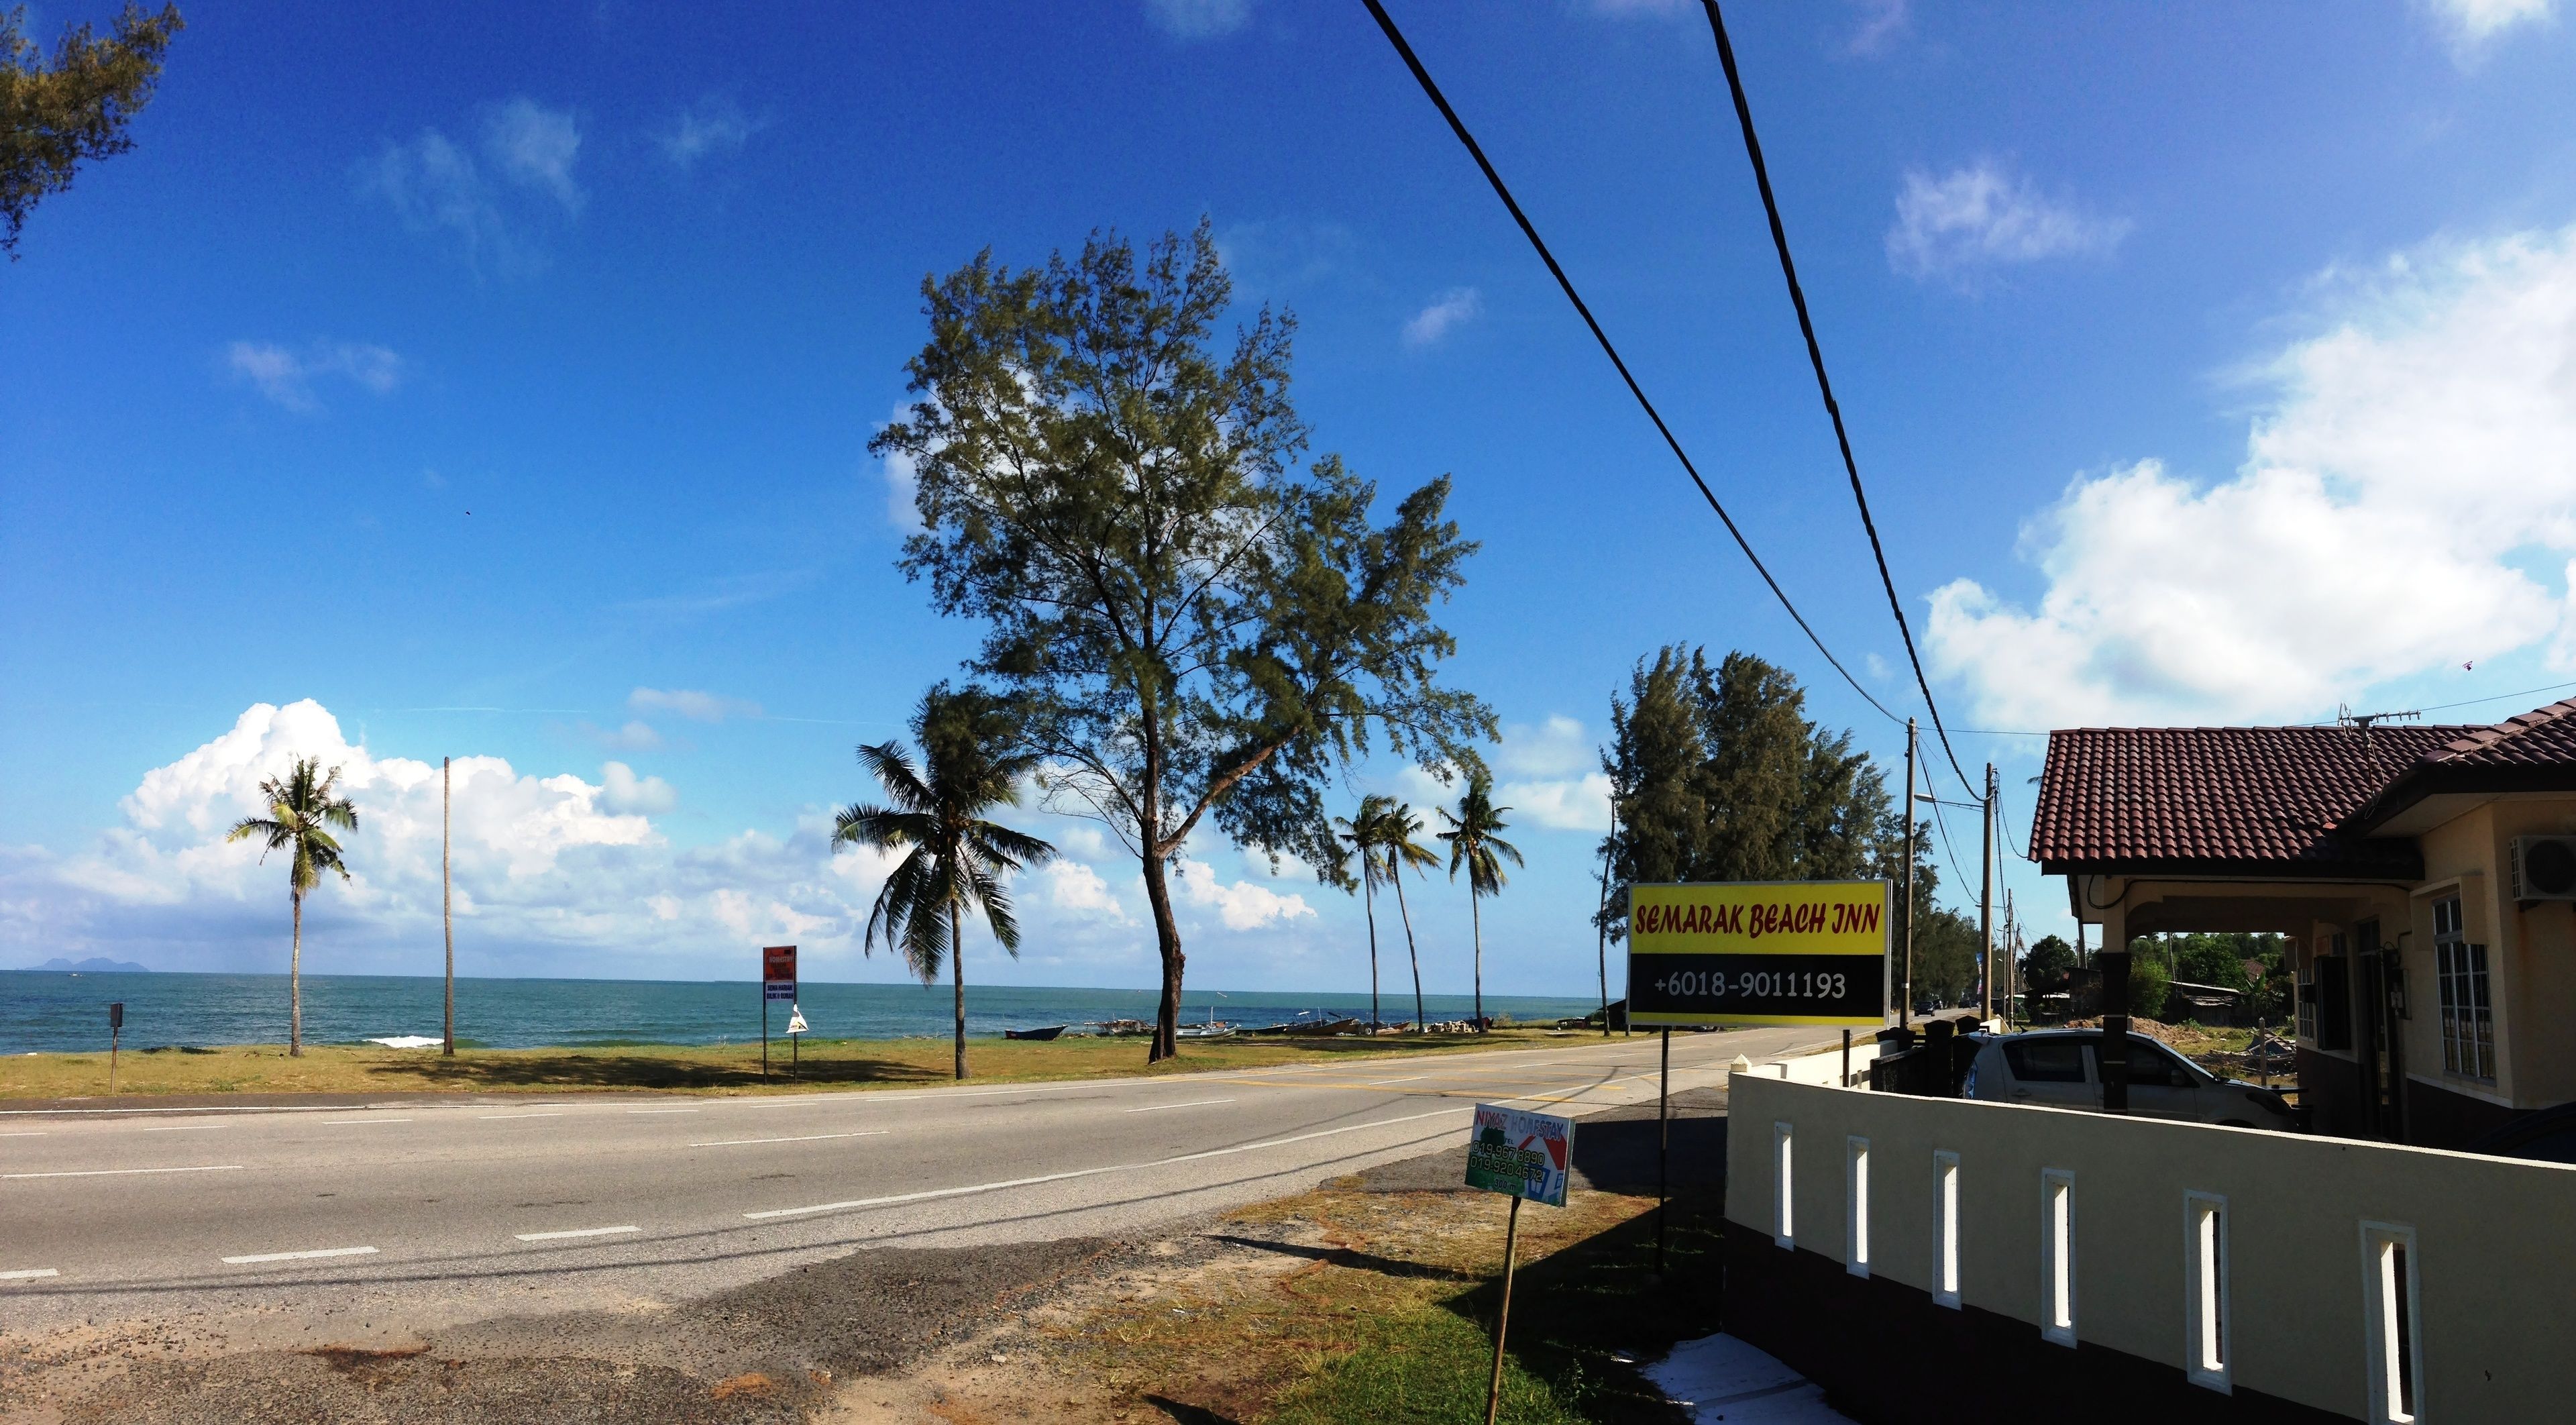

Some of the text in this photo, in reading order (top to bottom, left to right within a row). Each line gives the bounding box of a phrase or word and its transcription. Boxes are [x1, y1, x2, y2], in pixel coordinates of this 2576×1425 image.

[1635, 902, 1880, 939] SEMARAK BEACH INN
[1654, 971, 1846, 999] +6018-9011193
[1476, 1110, 1508, 1130] NIYAZ
